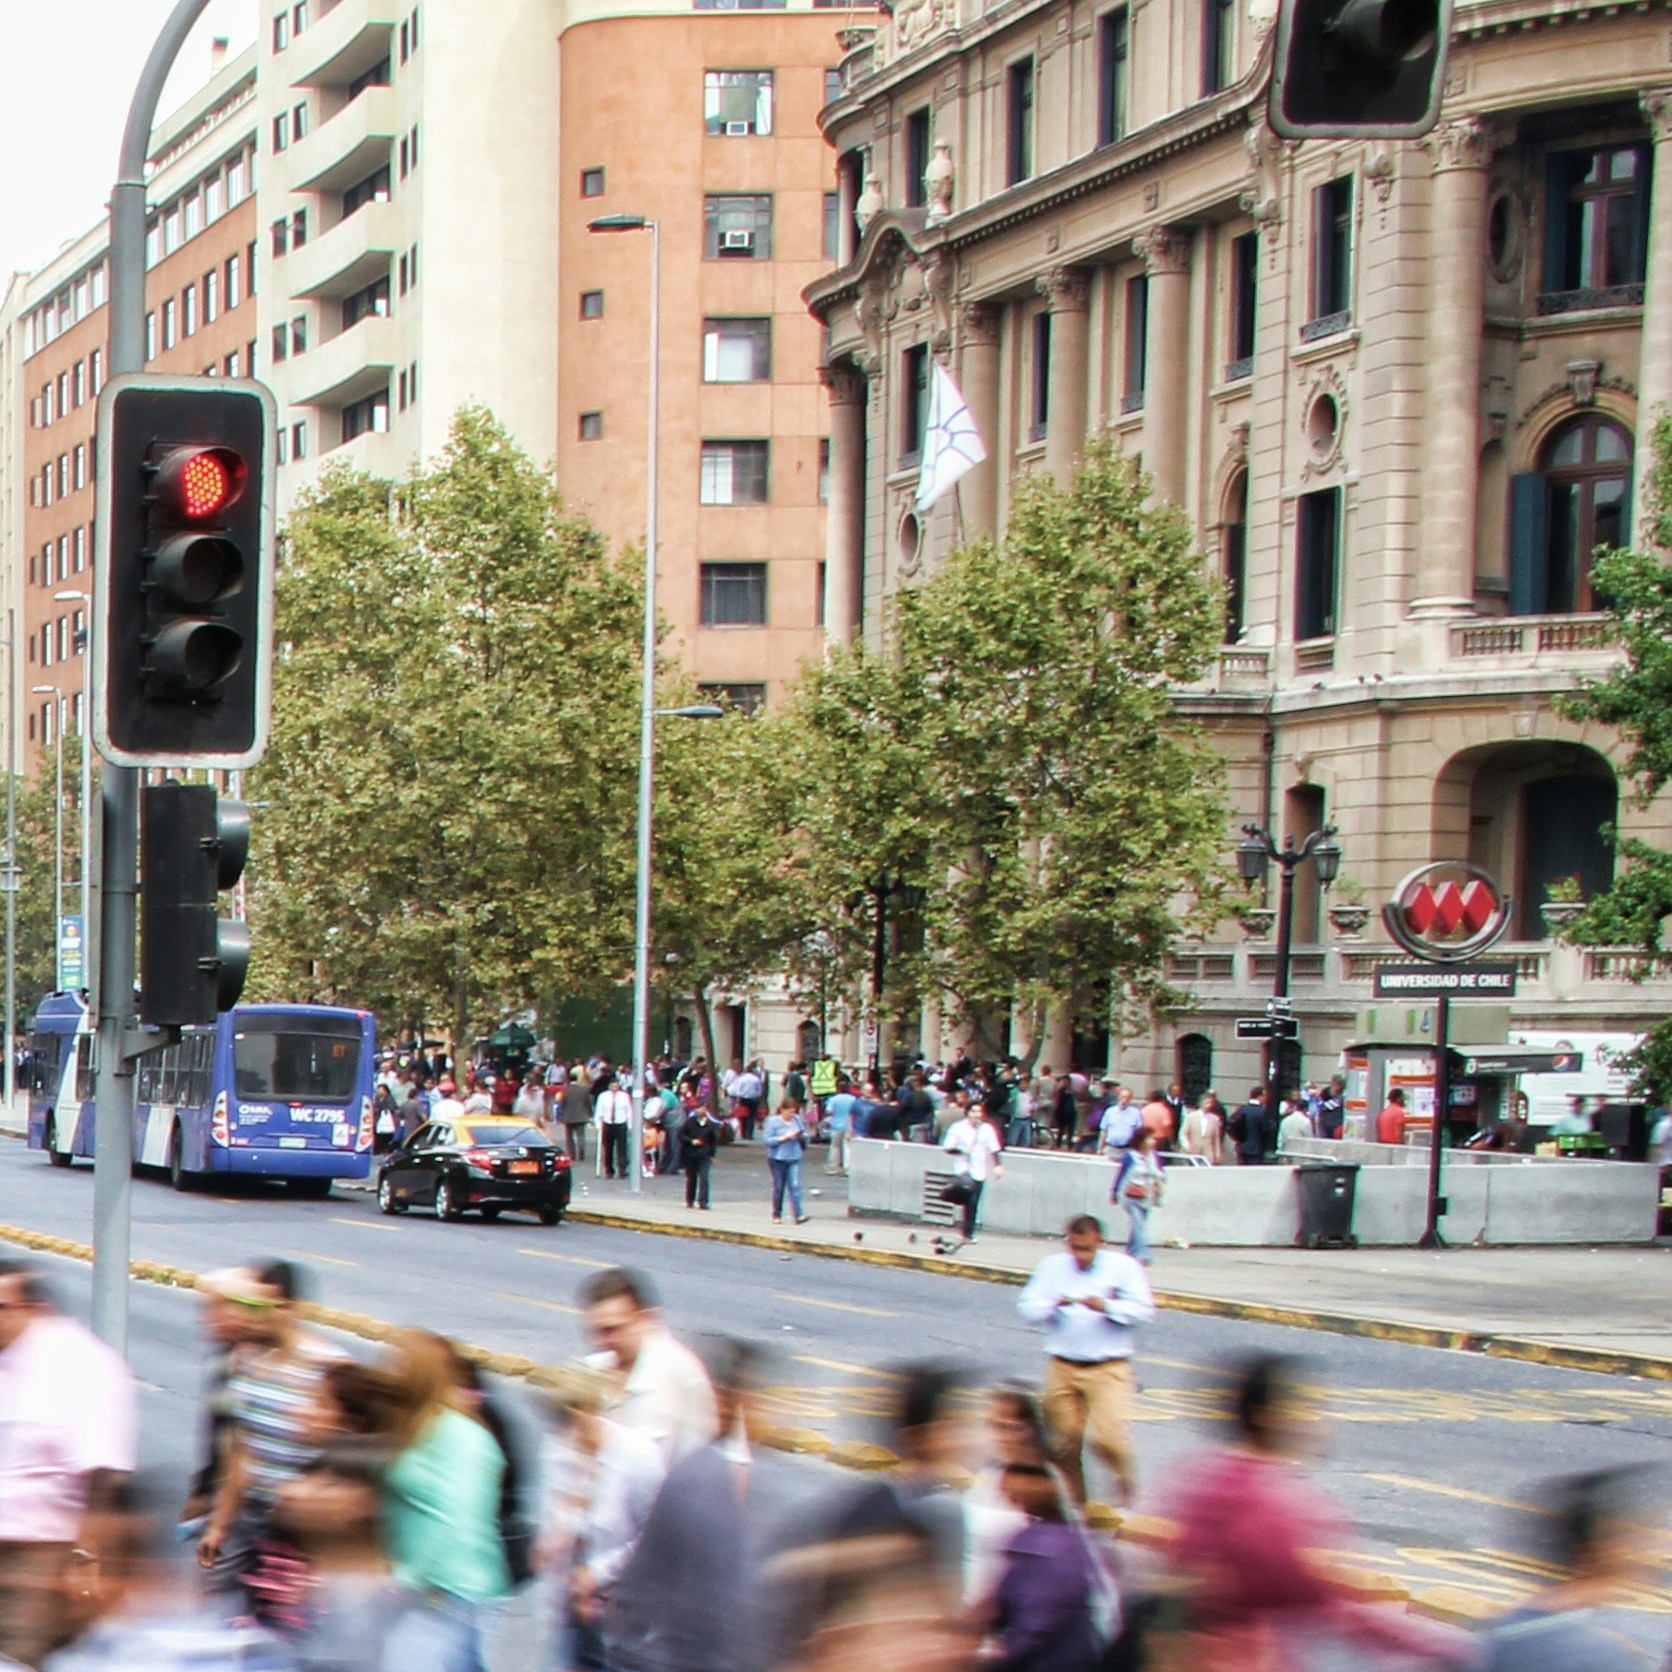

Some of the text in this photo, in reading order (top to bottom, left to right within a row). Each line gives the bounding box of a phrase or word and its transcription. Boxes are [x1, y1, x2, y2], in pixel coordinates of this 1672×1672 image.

[1380, 974, 1510, 988] UNIVERSIDAD DE CHILE
[290, 1107, 313, 1122] WC
[314, 1109, 346, 1124] 2795
